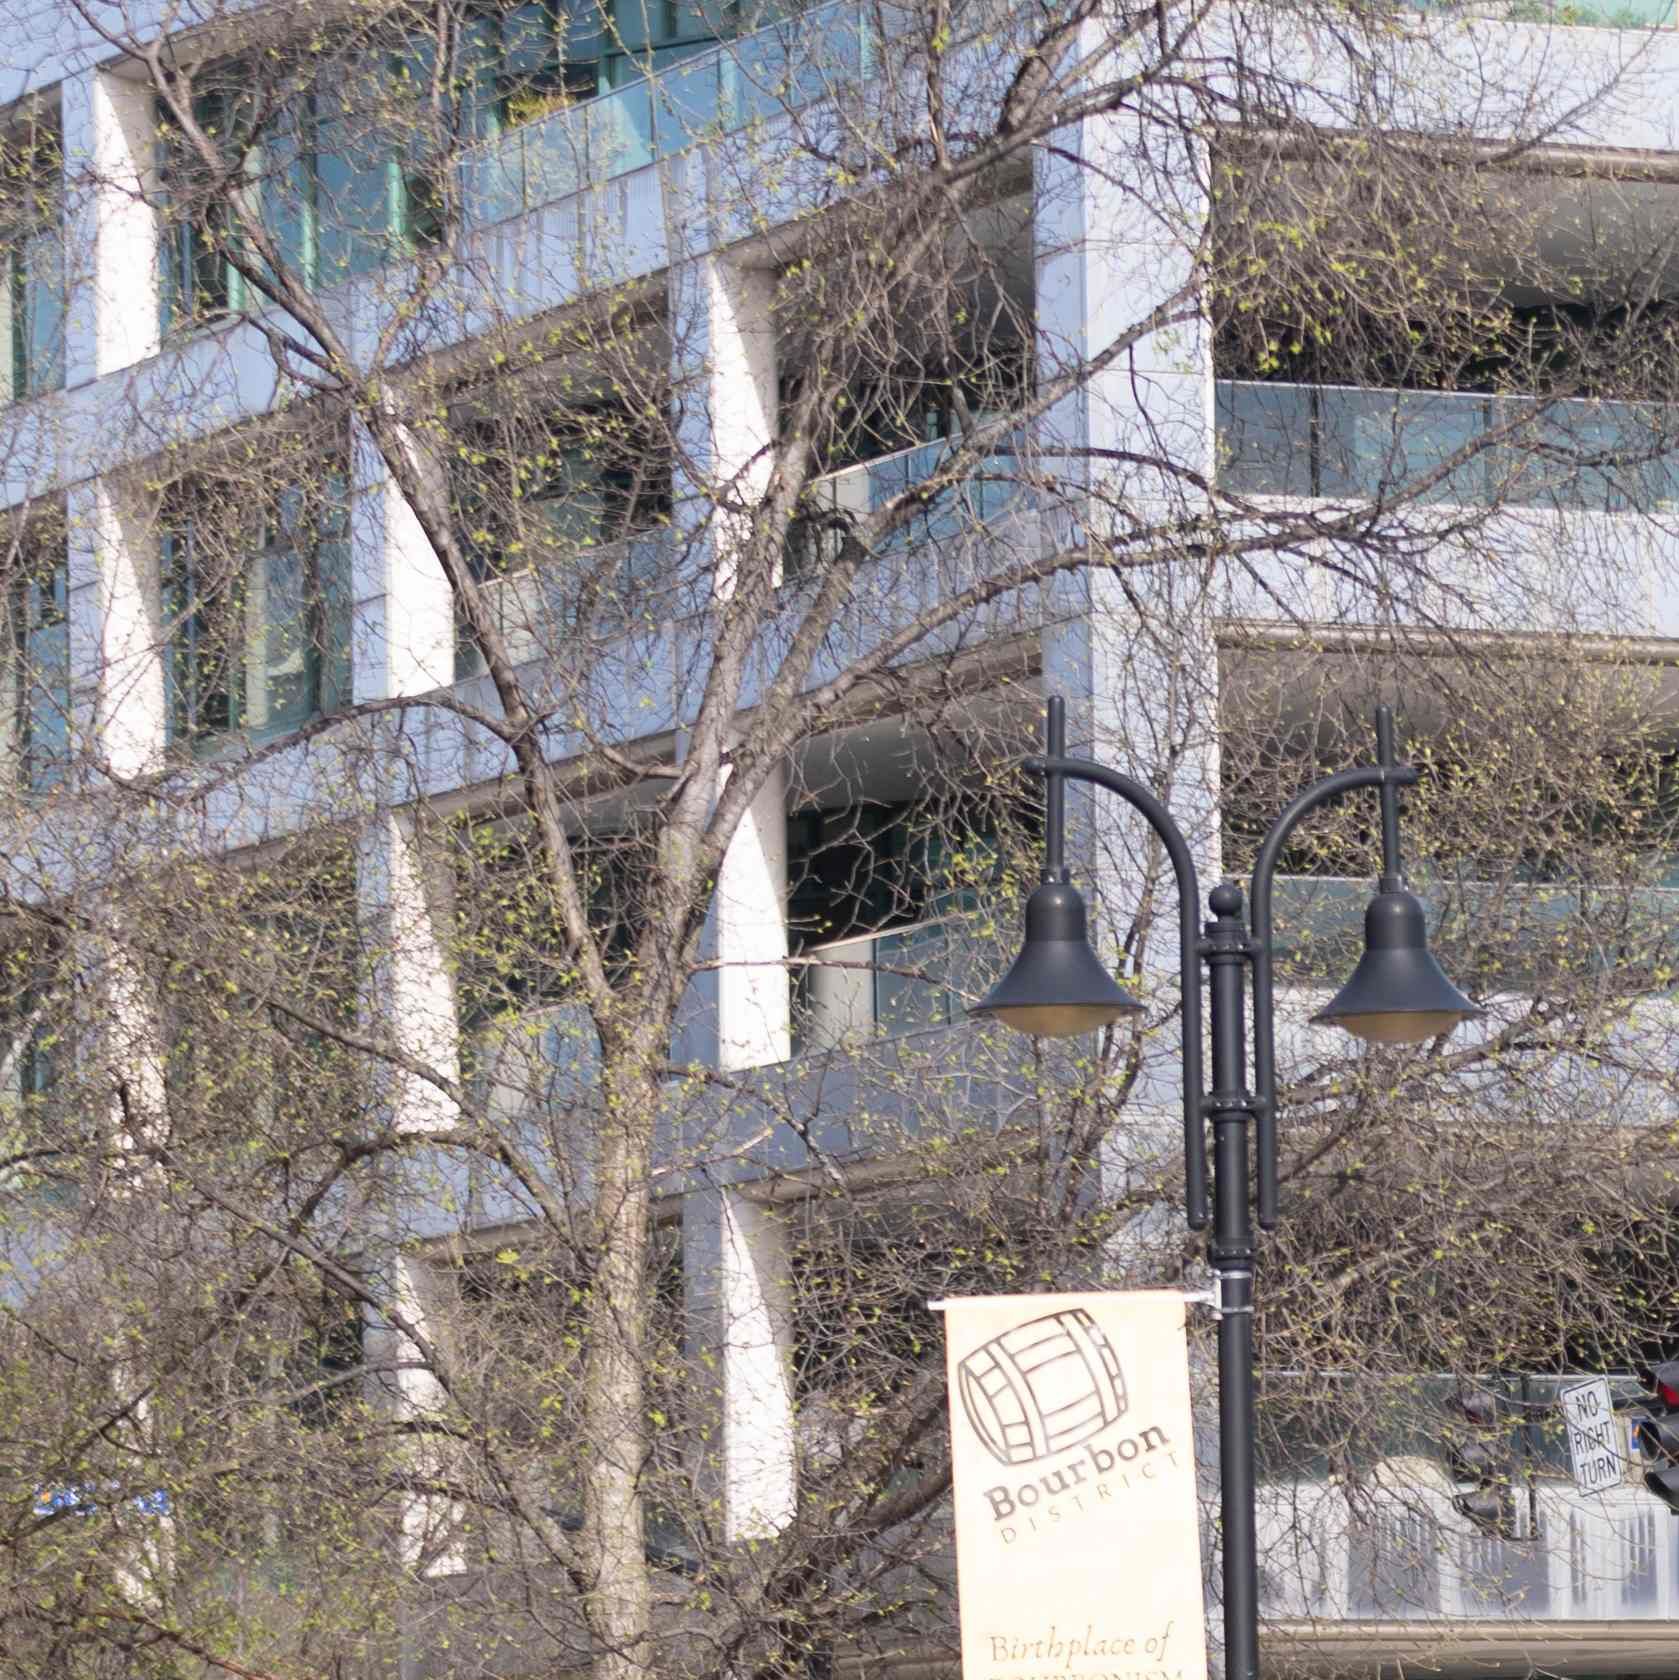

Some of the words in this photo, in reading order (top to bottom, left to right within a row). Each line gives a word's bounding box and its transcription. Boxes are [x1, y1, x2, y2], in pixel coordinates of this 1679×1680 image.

[1575, 1391, 1600, 1421] NO
[1574, 1421, 1611, 1456] RIGHT
[983, 1425, 1171, 1522] Bourbon
[1580, 1456, 1617, 1489] TURN
[1000, 1451, 1178, 1545] DISTRICT
[988, 1624, 1136, 1669] Birthplace
[1144, 1620, 1175, 1662] of
